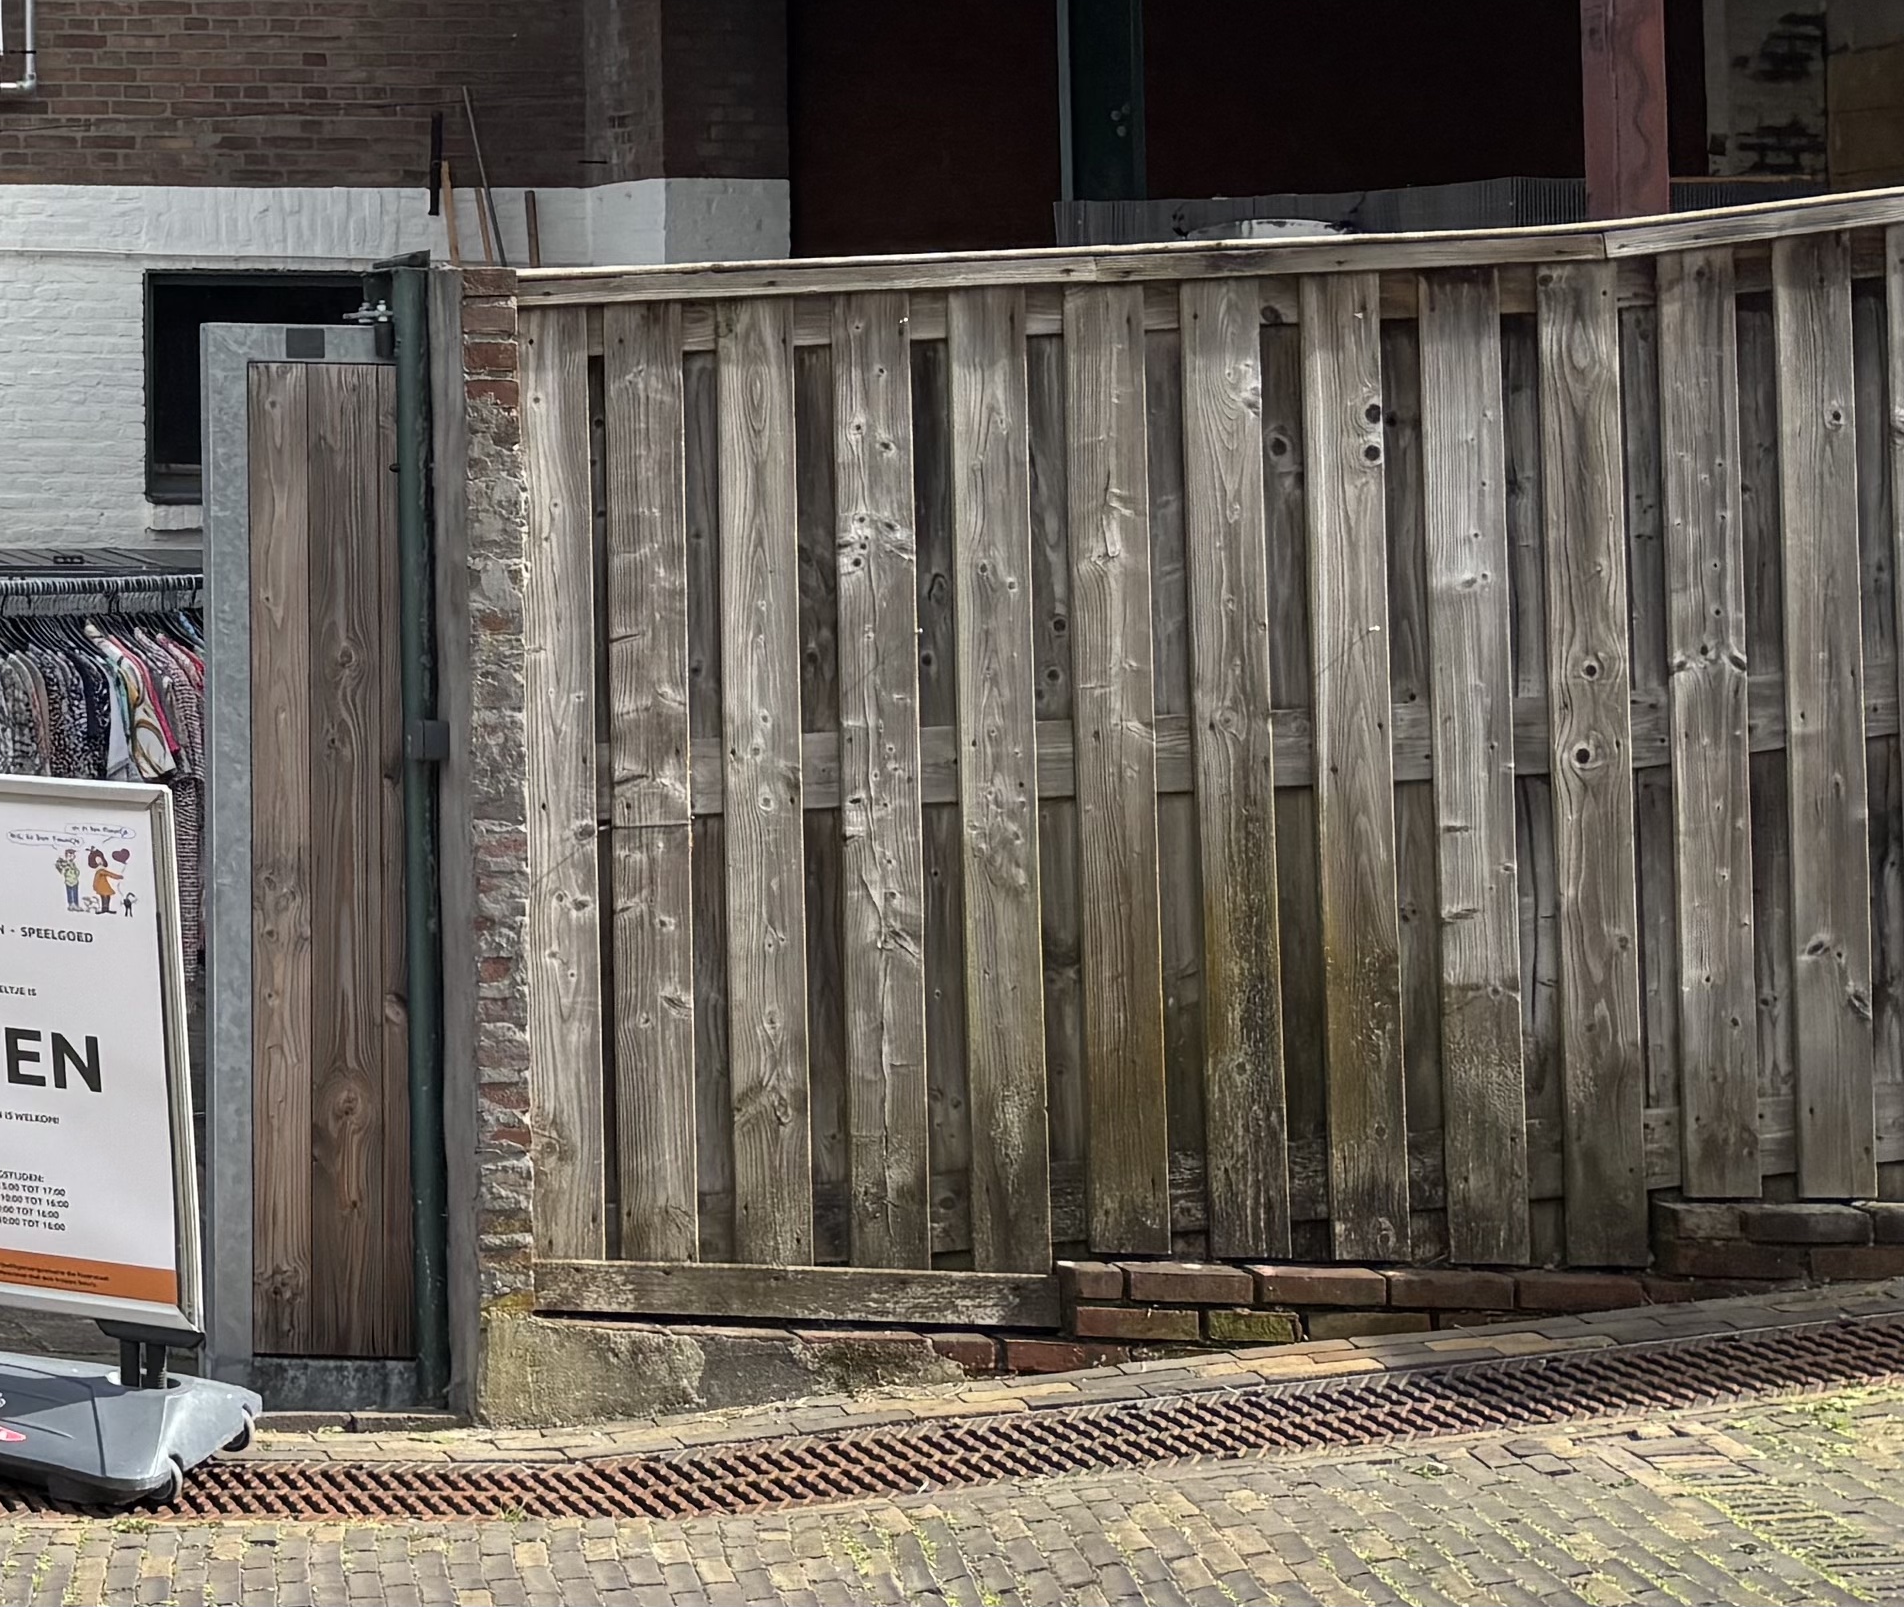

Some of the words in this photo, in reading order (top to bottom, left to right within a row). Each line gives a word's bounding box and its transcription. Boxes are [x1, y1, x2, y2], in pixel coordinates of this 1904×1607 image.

[20, 926, 94, 944] SPEELGOED
[21, 1184, 39, 1194] TOT
[25, 1196, 42, 1206] TOT
[16, 1206, 33, 1216] TOT
[22, 1219, 40, 1229] TOT
